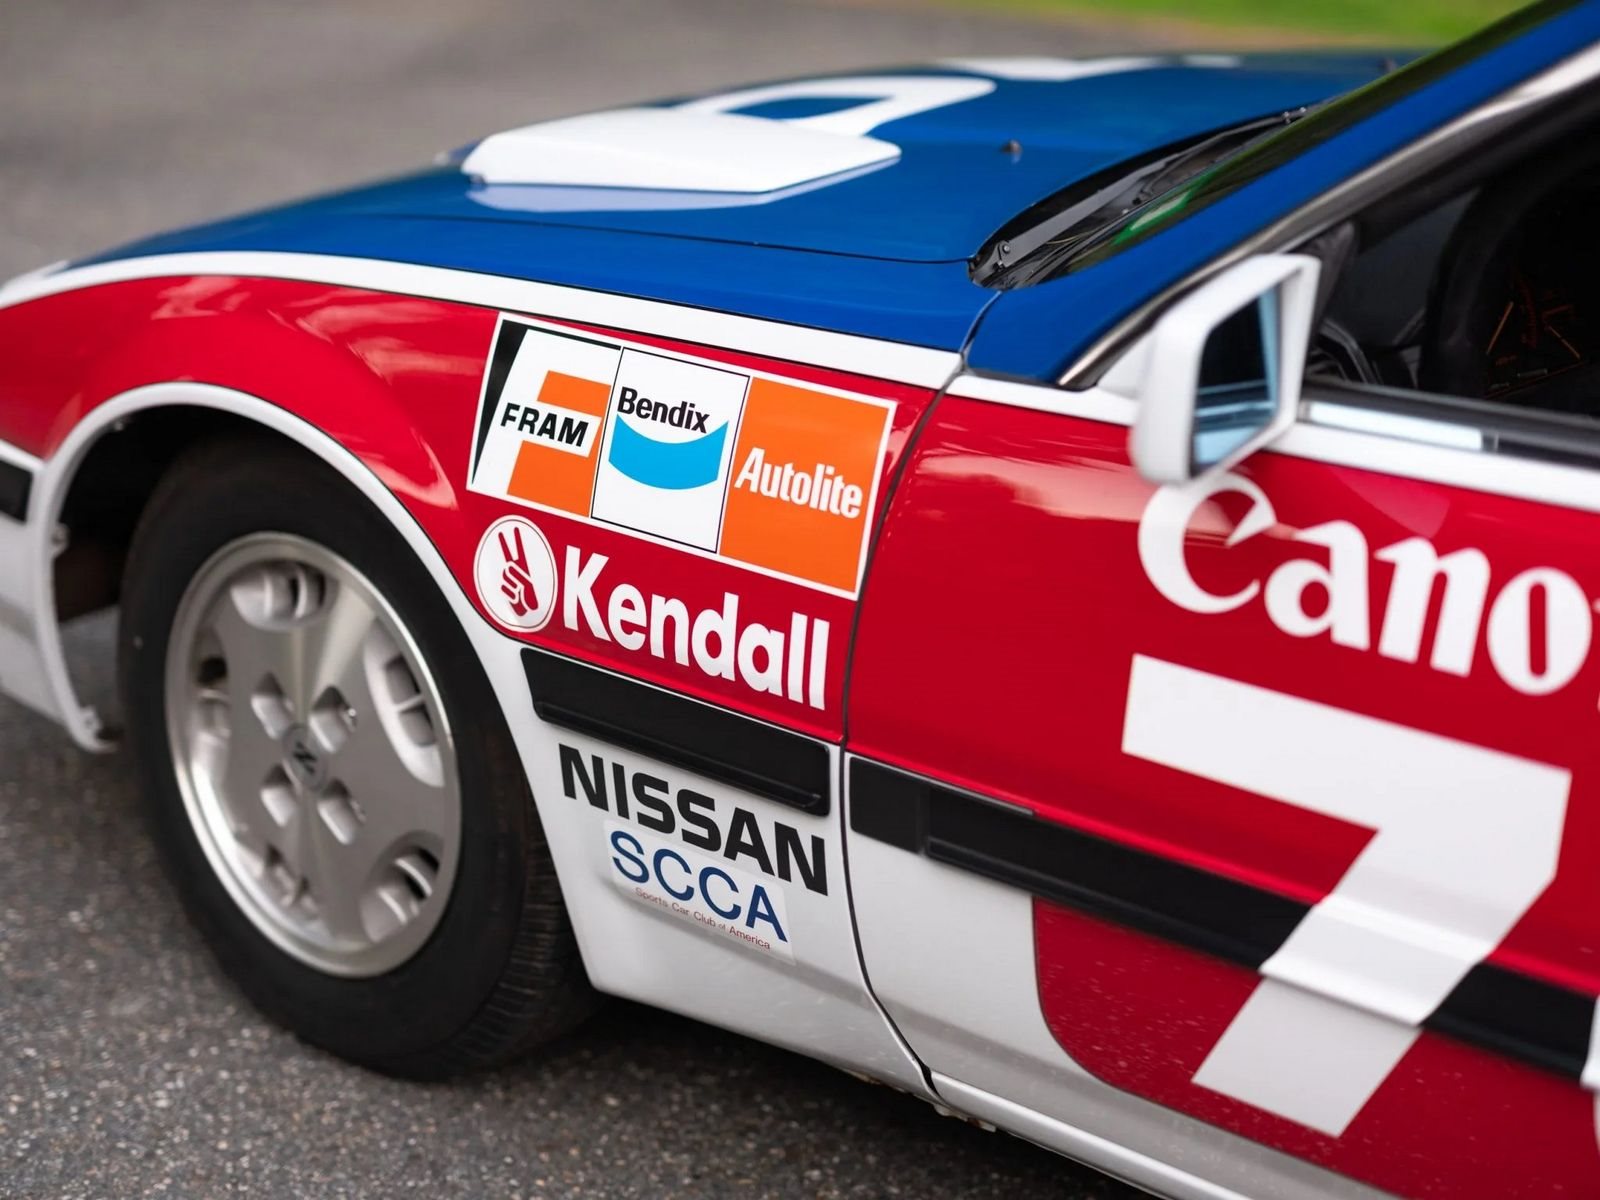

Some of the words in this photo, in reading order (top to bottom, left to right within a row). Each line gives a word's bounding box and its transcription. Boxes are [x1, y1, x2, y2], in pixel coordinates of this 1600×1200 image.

[501, 402, 589, 448] FRAM
[617, 386, 710, 434] Bendix
[734, 447, 863, 519] Autolite
[563, 544, 830, 711] Kendall
[1138, 473, 1600, 712] Cano
[559, 743, 828, 896] NISSAN
[610, 830, 788, 942] SCCA
[635, 886, 669, 908] Sports
[671, 902, 690, 916] Car
[693, 911, 716, 927] Club
[729, 926, 771, 950] America
